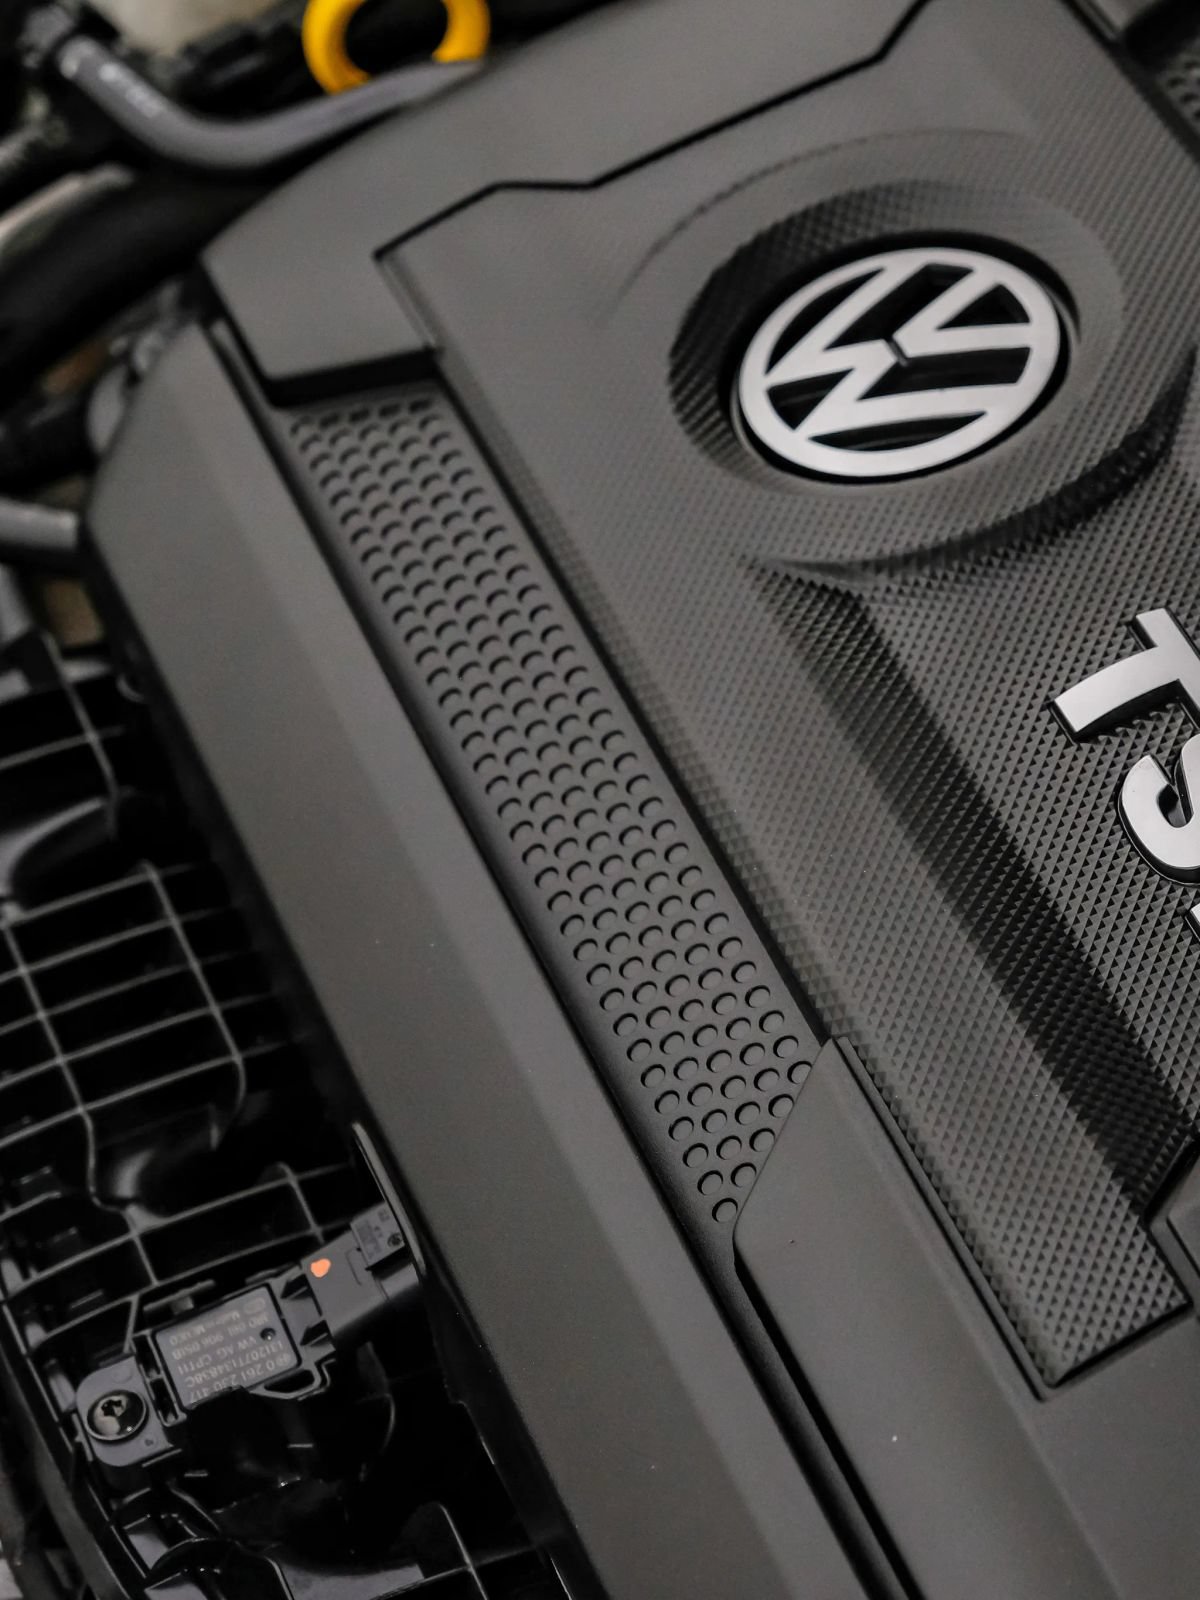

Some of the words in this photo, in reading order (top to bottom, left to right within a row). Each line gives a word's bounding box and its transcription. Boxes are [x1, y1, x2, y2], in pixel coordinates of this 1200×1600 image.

[237, 1335, 256, 1350] VW
[215, 1344, 234, 1358] AG
[239, 1363, 264, 1381] 261
